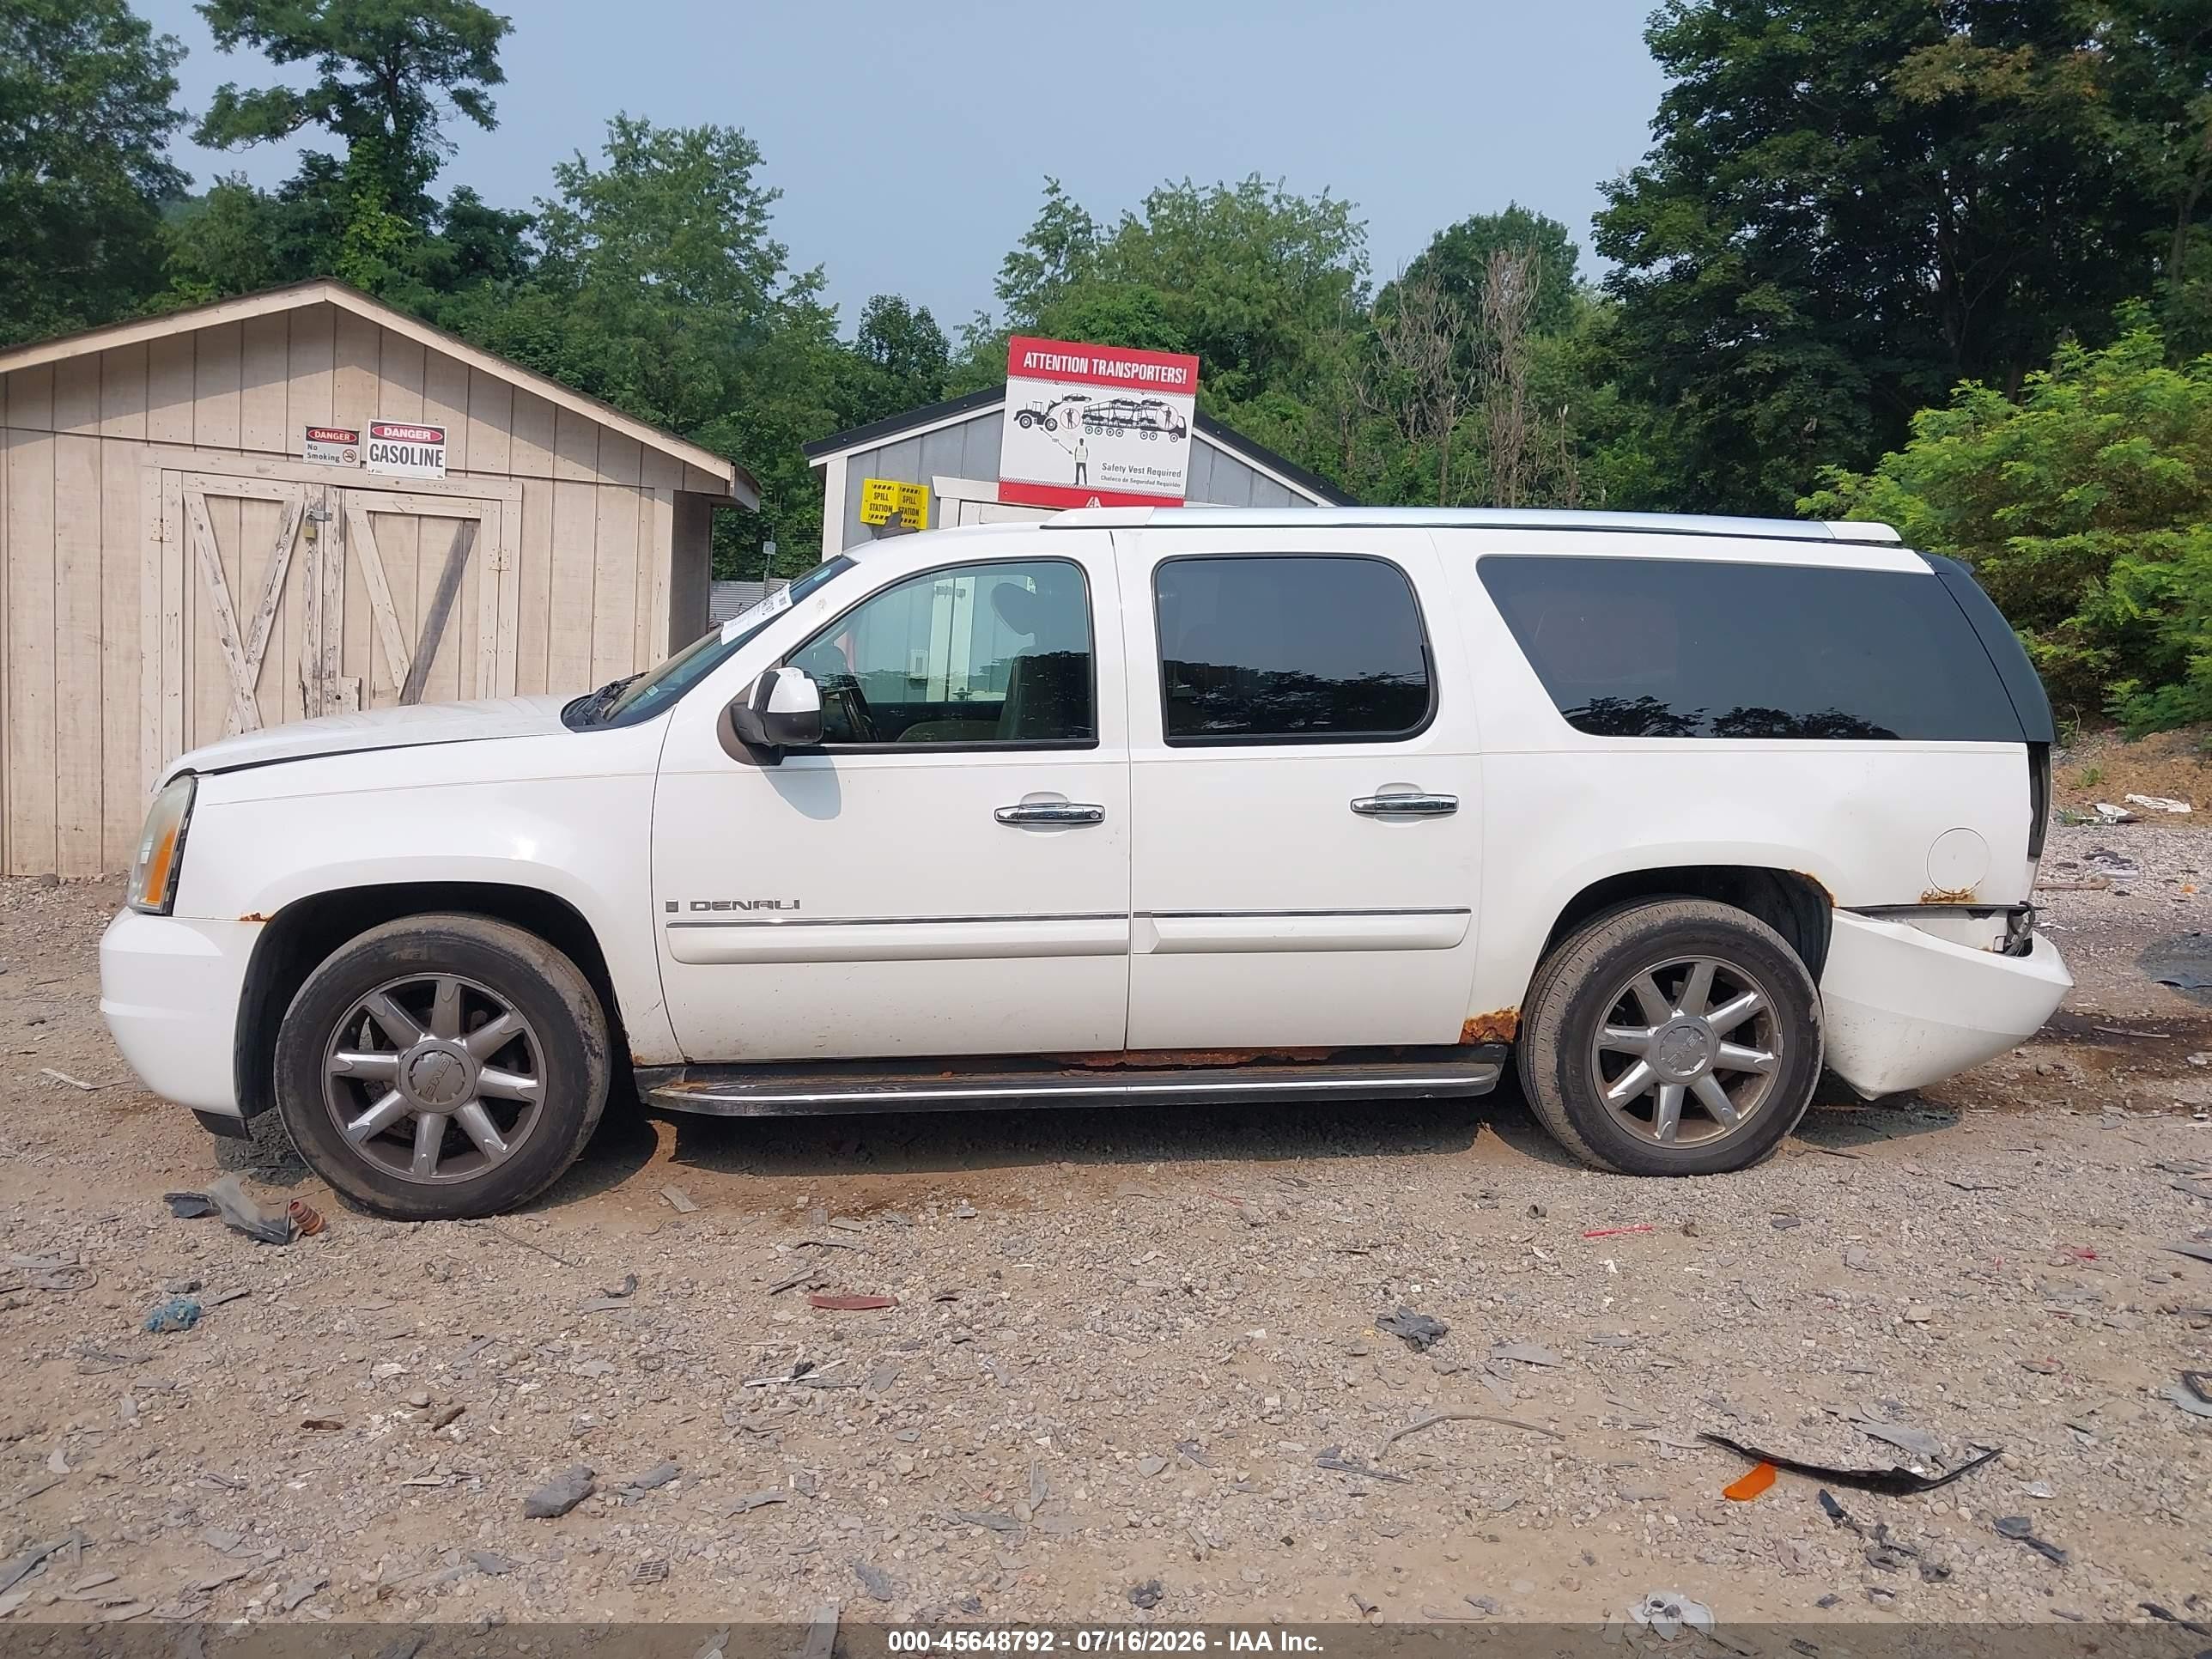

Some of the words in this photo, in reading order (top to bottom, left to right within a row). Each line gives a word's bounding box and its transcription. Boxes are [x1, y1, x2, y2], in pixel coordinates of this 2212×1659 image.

[1023, 352, 1089, 375] ATTENTION
[1091, 359, 1188, 385] TRANSPORTERS!
[314, 430, 350, 441] DANGER
[383, 427, 431, 441] DANGER
[307, 452, 340, 464] Smoking
[369, 443, 444, 468] GASOLINE
[1101, 462, 1127, 474] Safety
[1128, 465, 1145, 474] Vest
[1146, 466, 1182, 478] Required
[873, 492, 889, 501] SPILL
[902, 495, 916, 505] SPILL
[869, 503, 893, 514] STATION
[690, 899, 800, 912] DENALI
